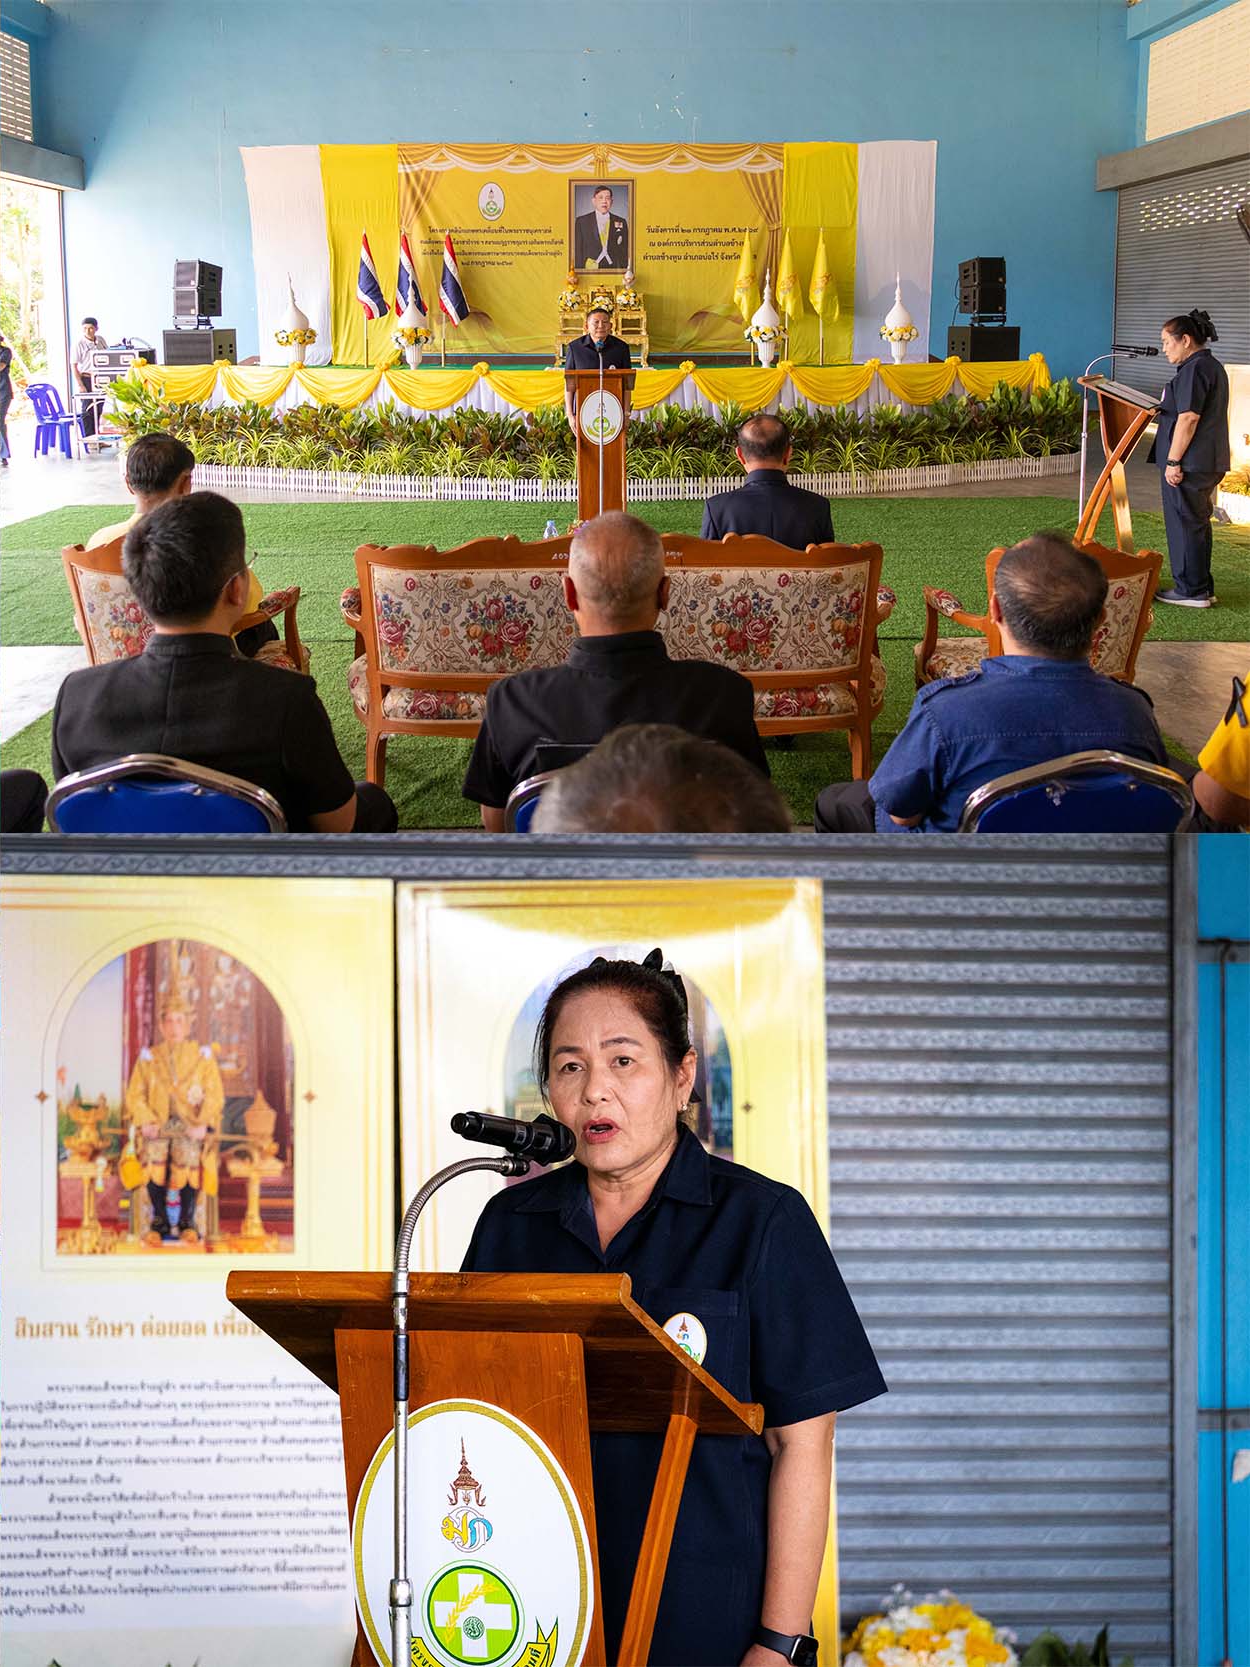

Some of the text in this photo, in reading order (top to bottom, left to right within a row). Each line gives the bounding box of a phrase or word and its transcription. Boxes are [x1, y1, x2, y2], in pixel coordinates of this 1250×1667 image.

[86, 1315, 135, 1338] รักษา
[141, 1314, 207, 1337] ต่อยอด
